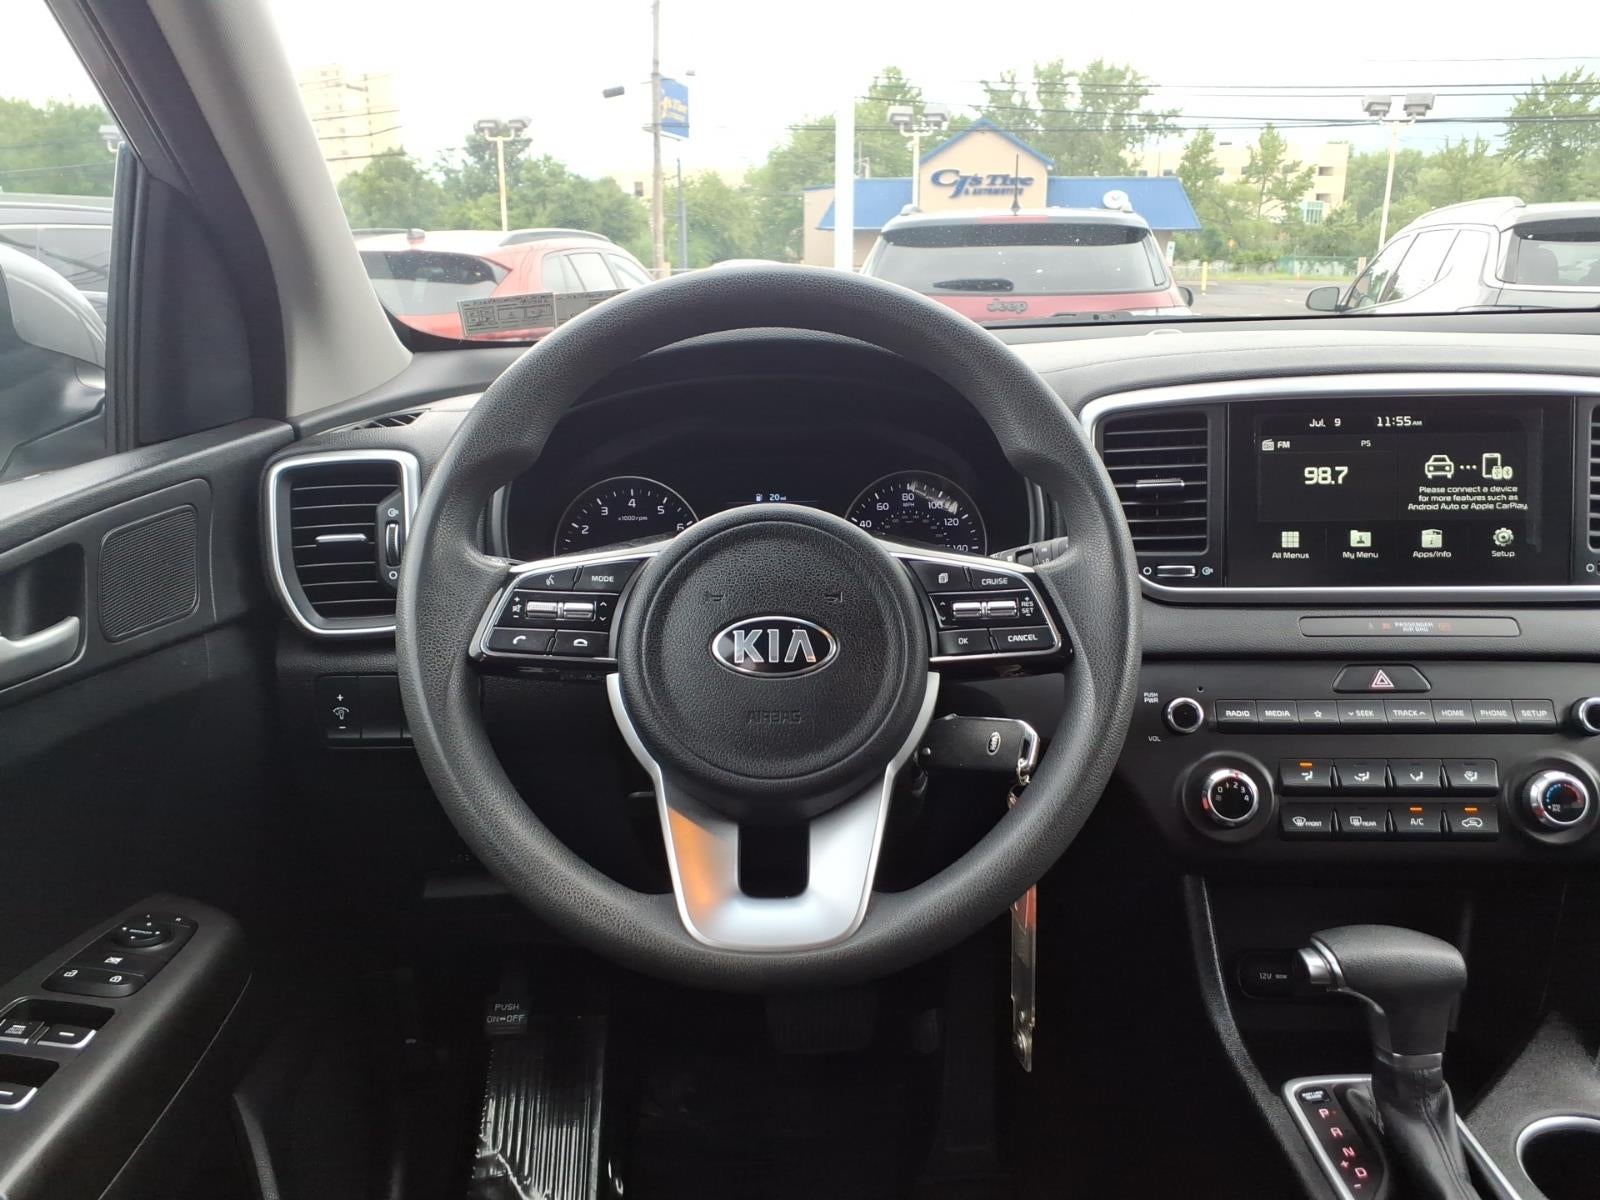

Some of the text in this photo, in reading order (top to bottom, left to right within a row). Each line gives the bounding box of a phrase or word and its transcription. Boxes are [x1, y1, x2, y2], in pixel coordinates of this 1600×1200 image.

[987, 298, 1028, 314] Jeep
[1334, 418, 1341, 427] 9
[1377, 416, 1412, 427] 11:55
[1277, 440, 1291, 449] FM
[1304, 466, 1349, 485] 98.7
[1490, 485, 1518, 493] device
[902, 493, 914, 501] 80
[628, 499, 636, 508] 4
[877, 503, 889, 511] 60
[601, 507, 609, 516] 3
[657, 506, 665, 515] 5
[581, 525, 589, 534] 2
[1343, 551, 1379, 560] My Menu
[1413, 551, 1451, 559] Apps/Info
[1491, 550, 1515, 558] Setup
[981, 578, 1008, 586] CRUISE
[1007, 634, 1038, 642] CANCEL
[733, 629, 817, 663] KIA
[1244, 794, 1250, 802] 4
[1410, 818, 1424, 826] A/C
[1260, 972, 1272, 980] 12V
[494, 1003, 520, 1011] PUSH
[1318, 1108, 1330, 1119] P
[1330, 1127, 1343, 1137] R
[1342, 1147, 1355, 1157] N
[1355, 1167, 1368, 1178] D
